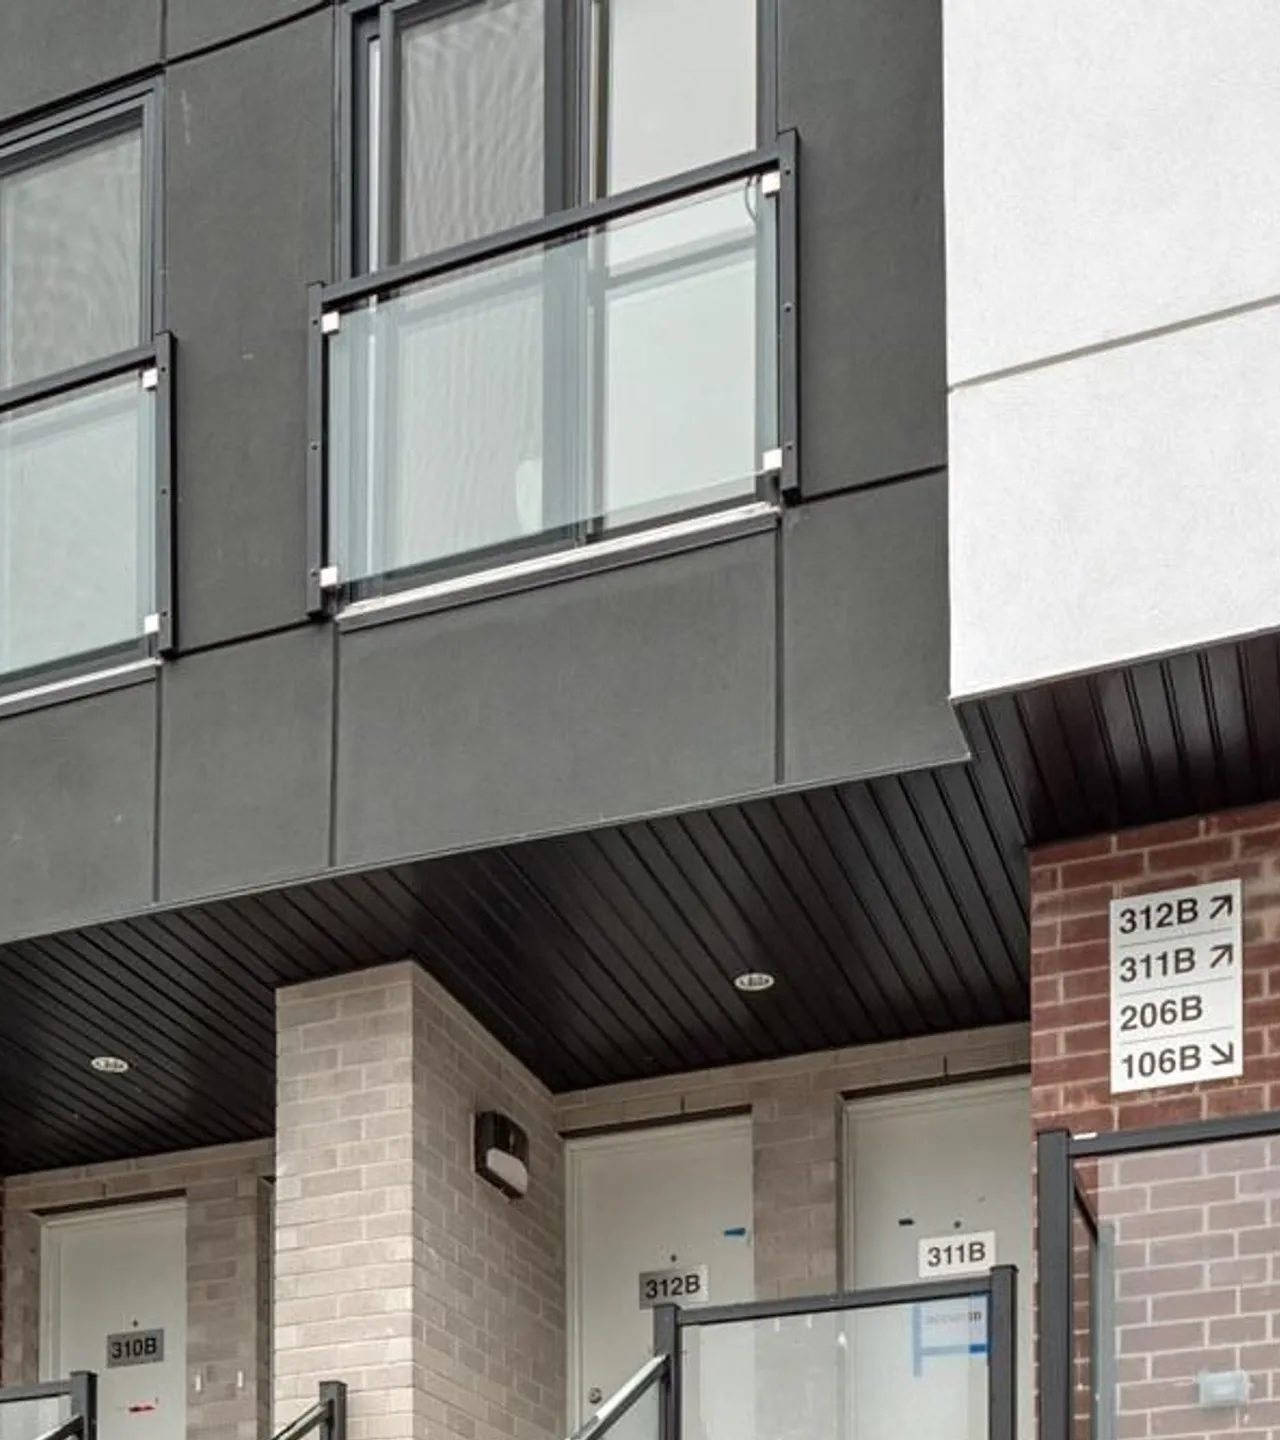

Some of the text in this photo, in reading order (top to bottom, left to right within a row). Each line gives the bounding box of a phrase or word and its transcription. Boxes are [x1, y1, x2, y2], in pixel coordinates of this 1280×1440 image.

[1119, 898, 1199, 935] 312B
[1119, 948, 1196, 983] 311B
[1120, 995, 1203, 1032] 206B
[1122, 1044, 1202, 1080] 106B
[927, 1241, 986, 1268] 311B
[645, 1273, 701, 1299] 312B
[111, 1337, 157, 1359] 310B
